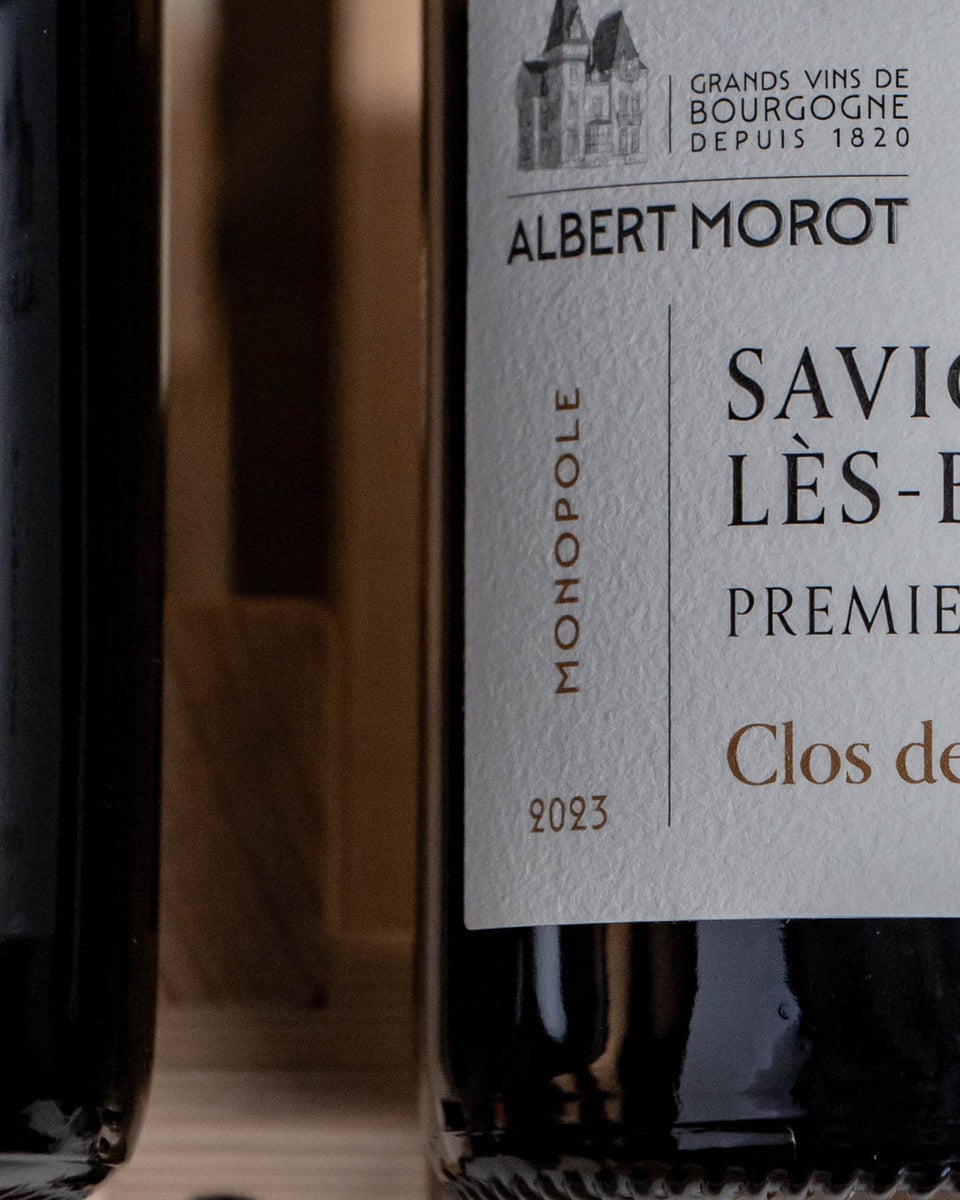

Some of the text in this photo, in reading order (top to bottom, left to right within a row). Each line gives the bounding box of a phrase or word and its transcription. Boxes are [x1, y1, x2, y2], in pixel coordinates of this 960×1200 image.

[690, 67, 909, 95] GRANDS VINS DE
[690, 93, 910, 126] BOURGOGNE
[690, 126, 910, 153] DEPUIS 1820
[506, 196, 910, 266] ALBERT MOROT
[554, 387, 581, 695] MONOPOLE
[726, 720, 872, 787] Clos
[529, 794, 608, 834] 2023
